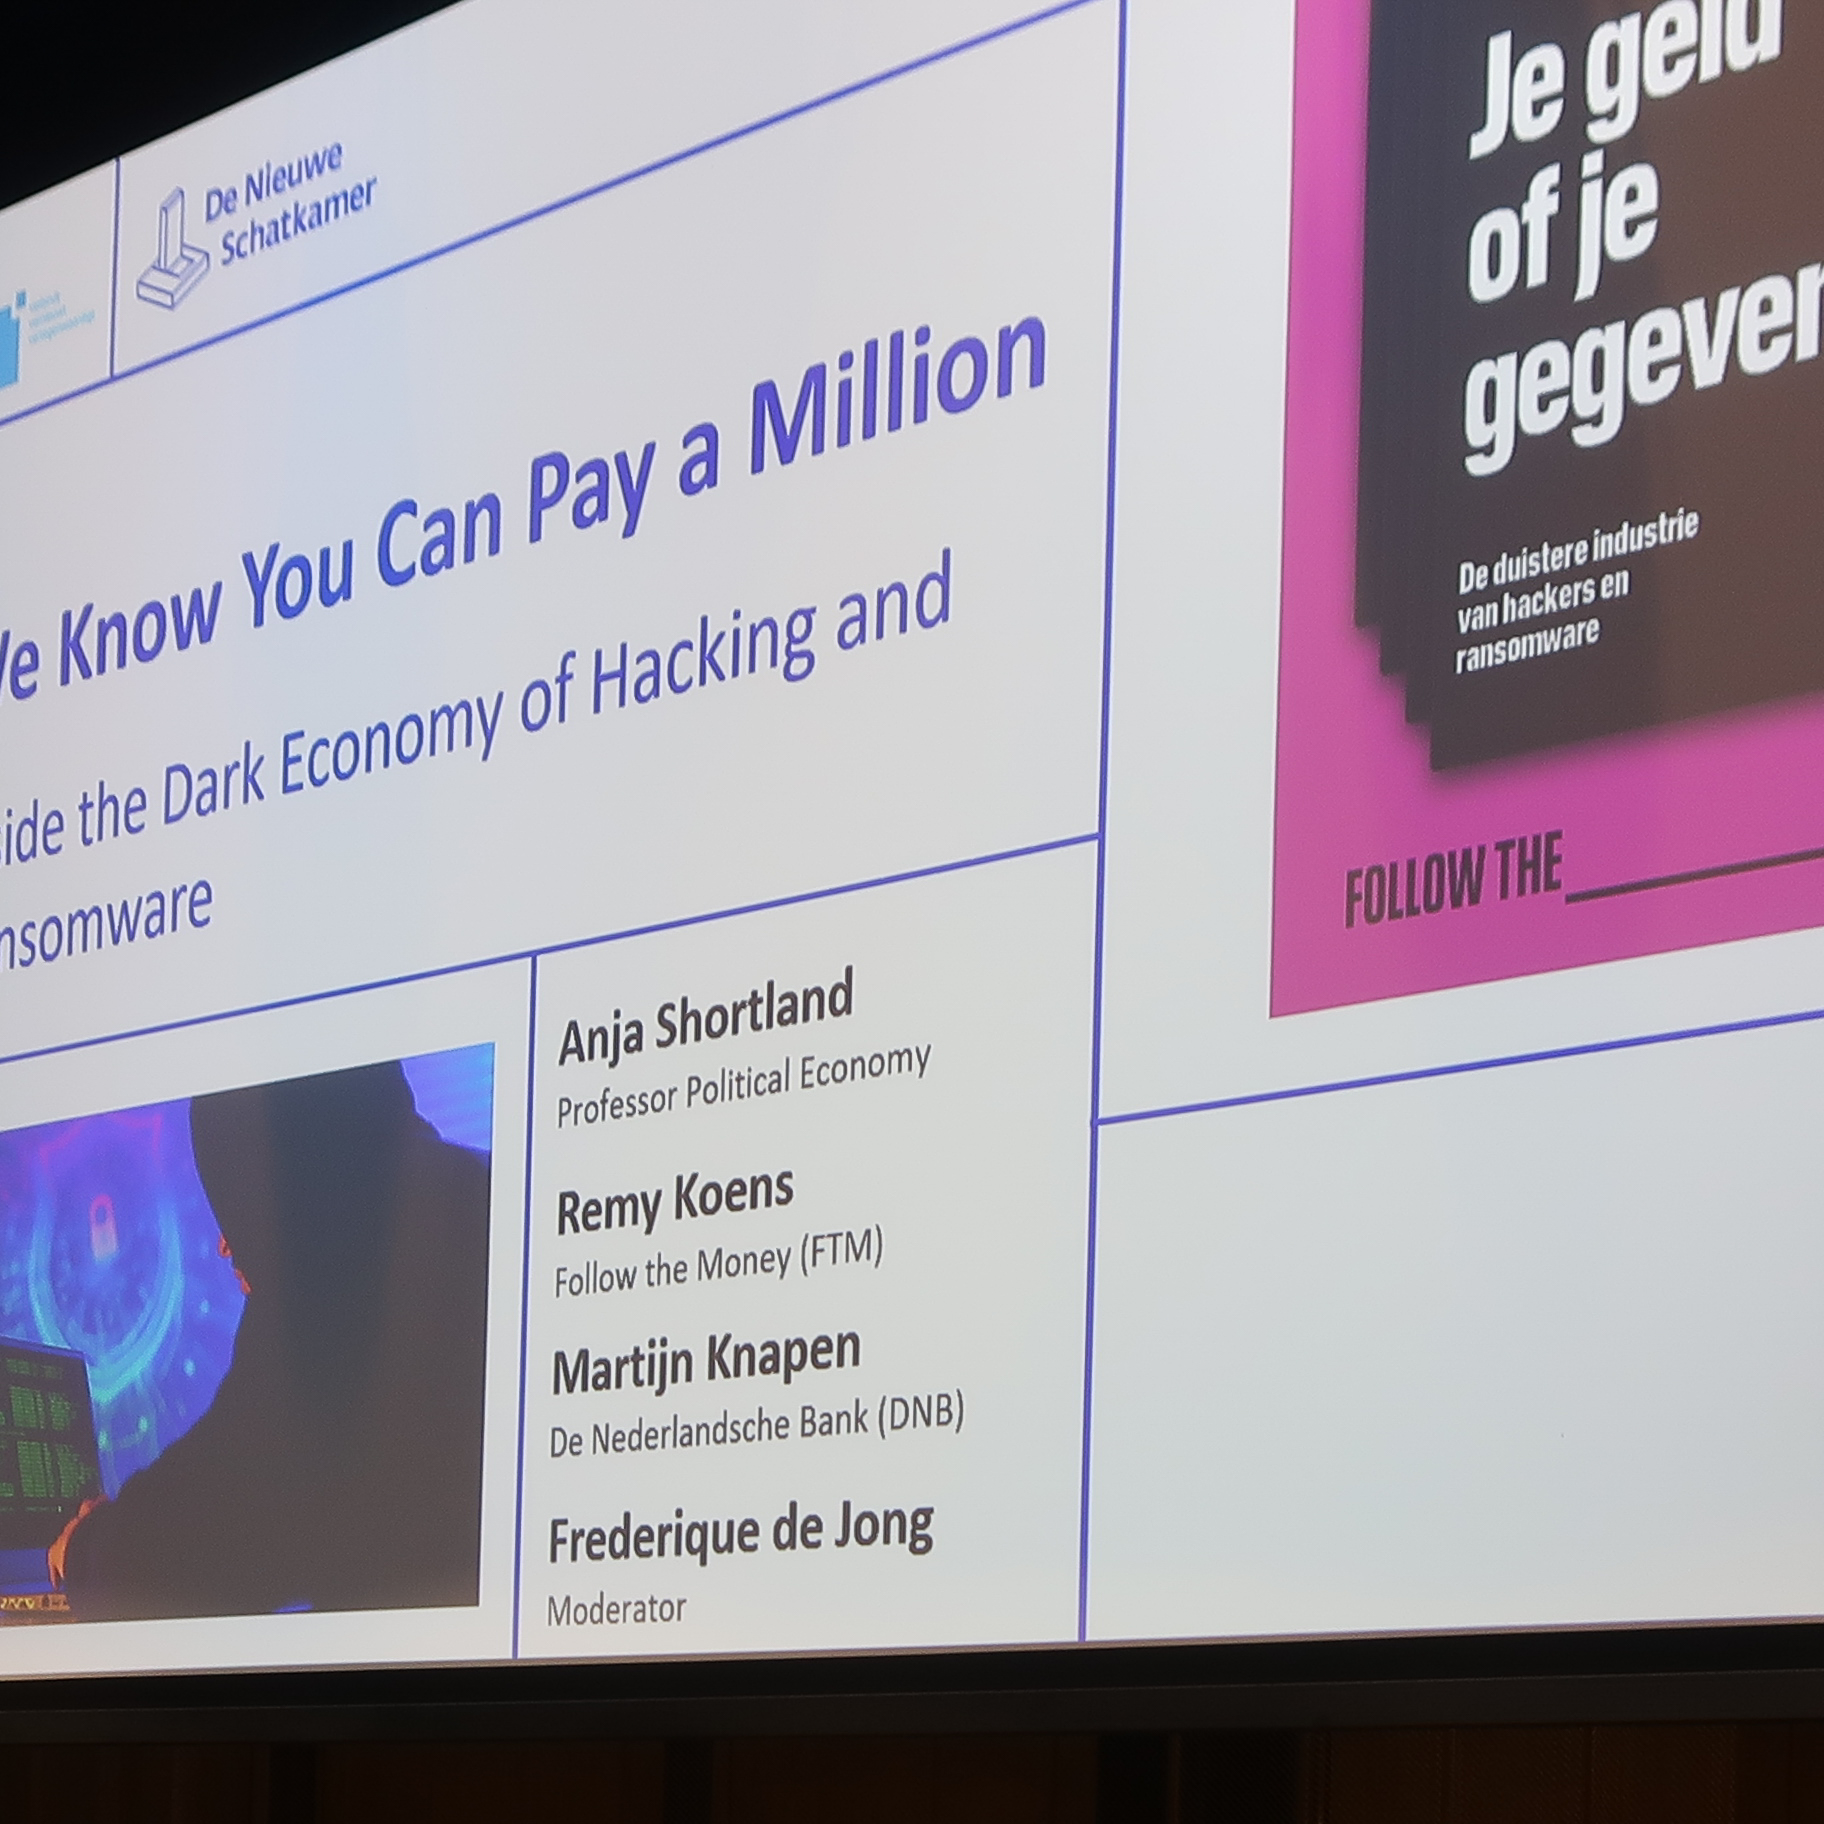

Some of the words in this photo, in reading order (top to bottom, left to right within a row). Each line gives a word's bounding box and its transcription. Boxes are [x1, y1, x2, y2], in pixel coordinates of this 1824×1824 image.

[1469, 29, 1565, 160] Je
[205, 186, 238, 225] De
[244, 142, 343, 208] Nieuwe
[221, 175, 378, 267] Schatkamer
[1468, 162, 1560, 304] of
[1574, 148, 1659, 302] je
[59, 580, 223, 687] Know
[241, 538, 354, 629] You
[377, 492, 502, 588] Can
[528, 440, 657, 545] Pay
[678, 421, 719, 497] a
[750, 315, 1046, 476] Million
[1459, 561, 1489, 595] De
[1492, 539, 1589, 586] duistere
[1592, 507, 1699, 562] industrie
[1457, 601, 1499, 634] van
[1502, 578, 1596, 625] hackers
[1600, 569, 1629, 599] en
[1456, 618, 1600, 675] ransomware
[77, 779, 147, 847] the
[163, 739, 265, 825] Dark
[281, 690, 505, 795] Economy
[520, 649, 577, 734] of
[592, 605, 817, 715] Hacking
[836, 546, 952, 651] and
[1345, 845, 1486, 929] FOLLOW
[1494, 830, 1563, 901] THE
[558, 1008, 644, 1070] Anja
[655, 964, 854, 1049] Shortland
[558, 1086, 678, 1129] Professor
[686, 1055, 790, 1109] Political
[800, 1043, 932, 1090] Economy
[557, 1188, 663, 1237] Remy
[674, 1170, 794, 1221] Koens
[555, 1259, 638, 1299] Follow
[644, 1251, 688, 1288] the
[697, 1246, 792, 1282] Money
[800, 1223, 883, 1278] (FTM)
[552, 1335, 693, 1398] Martijn
[707, 1331, 861, 1386] Knapen
[550, 1426, 583, 1459] De
[592, 1405, 790, 1456] Nederlandsche
[800, 1397, 869, 1439] Bank
[878, 1388, 964, 1441] (DNB)
[549, 1507, 760, 1568] Frederique
[772, 1499, 824, 1552] de
[834, 1499, 935, 1556] Jong
[547, 1590, 688, 1627] Moderator
